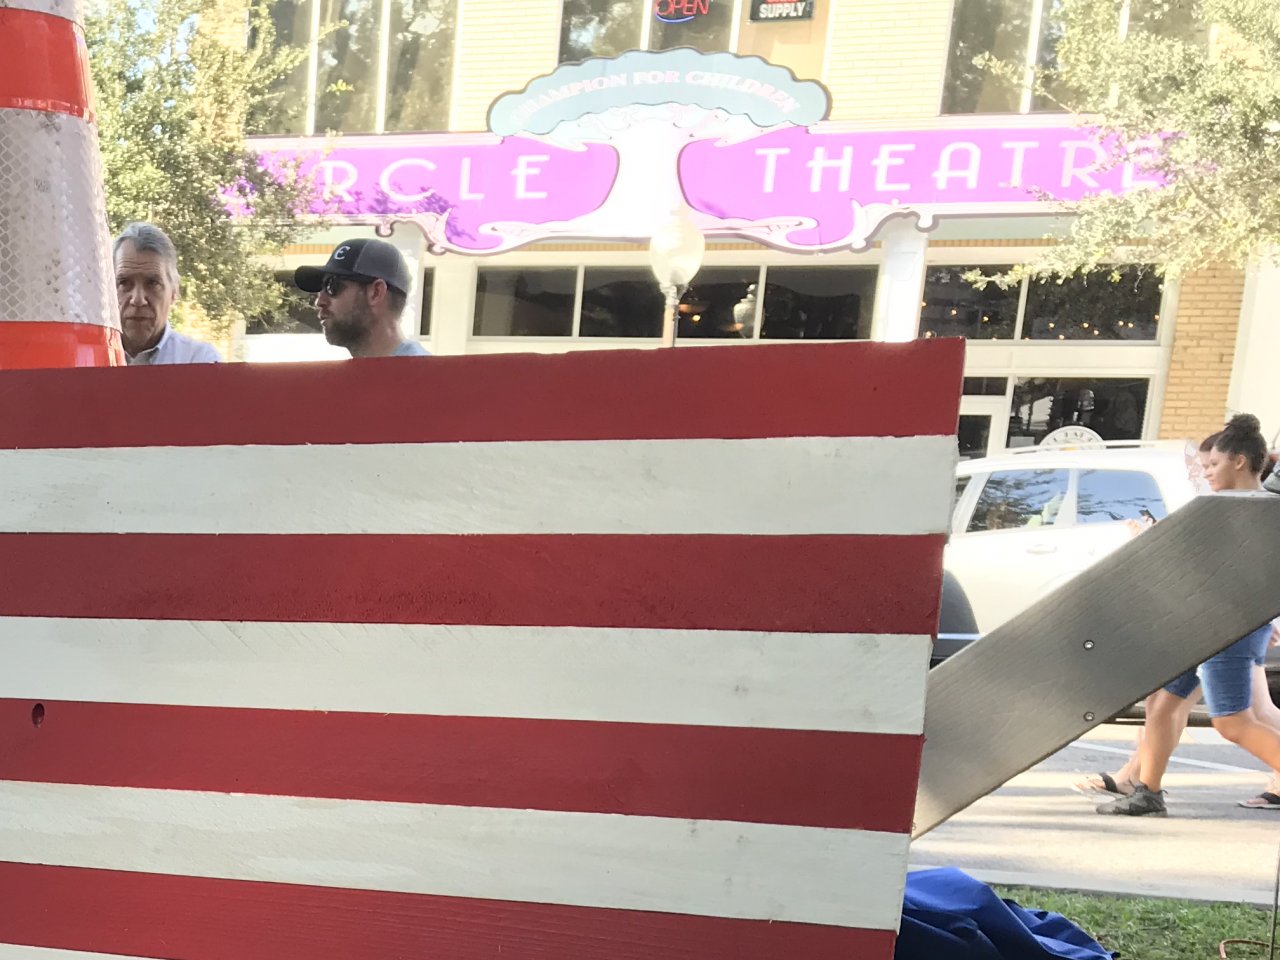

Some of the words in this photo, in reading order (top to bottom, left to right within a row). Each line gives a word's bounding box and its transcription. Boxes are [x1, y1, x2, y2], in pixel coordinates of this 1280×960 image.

[654, 0, 710, 16] OPEN
[759, 2, 806, 18] SUPPLY
[632, 70, 680, 86] FOR
[685, 70, 800, 114] CHILDREN
